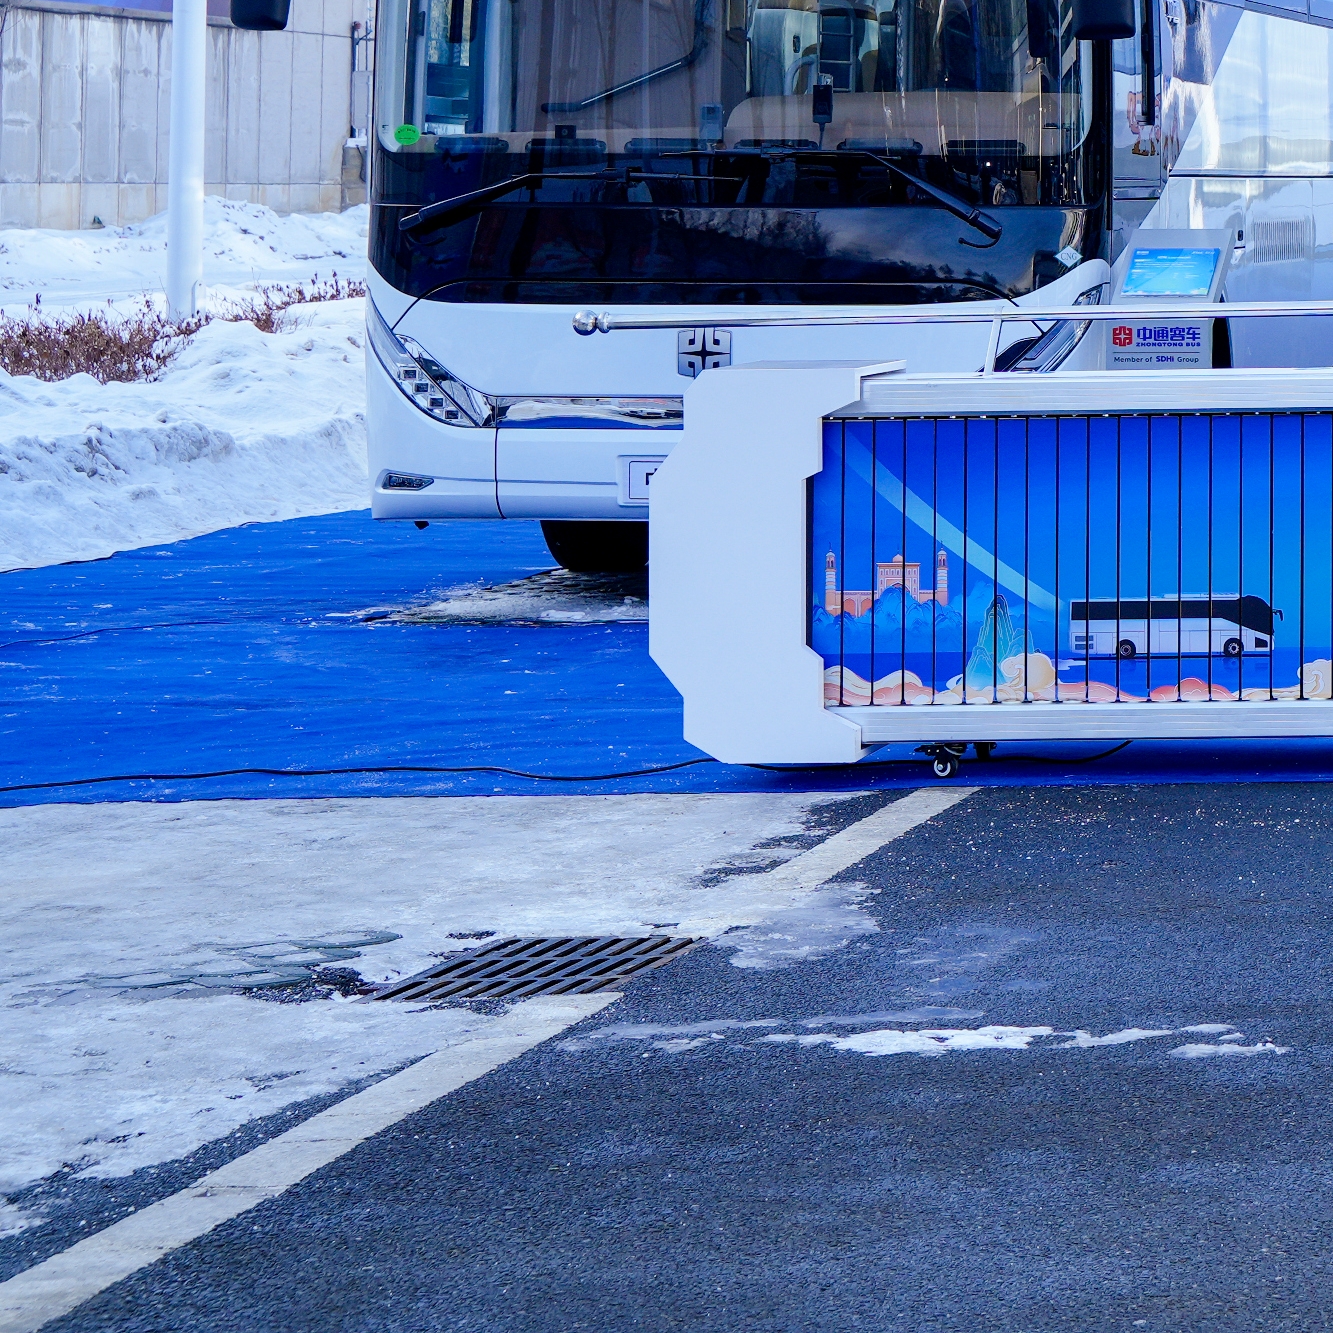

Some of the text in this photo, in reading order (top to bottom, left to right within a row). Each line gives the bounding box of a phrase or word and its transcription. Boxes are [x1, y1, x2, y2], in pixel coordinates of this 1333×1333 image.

[1060, 252, 1077, 261] CNG
[1136, 326, 1201, 341] 中通客车
